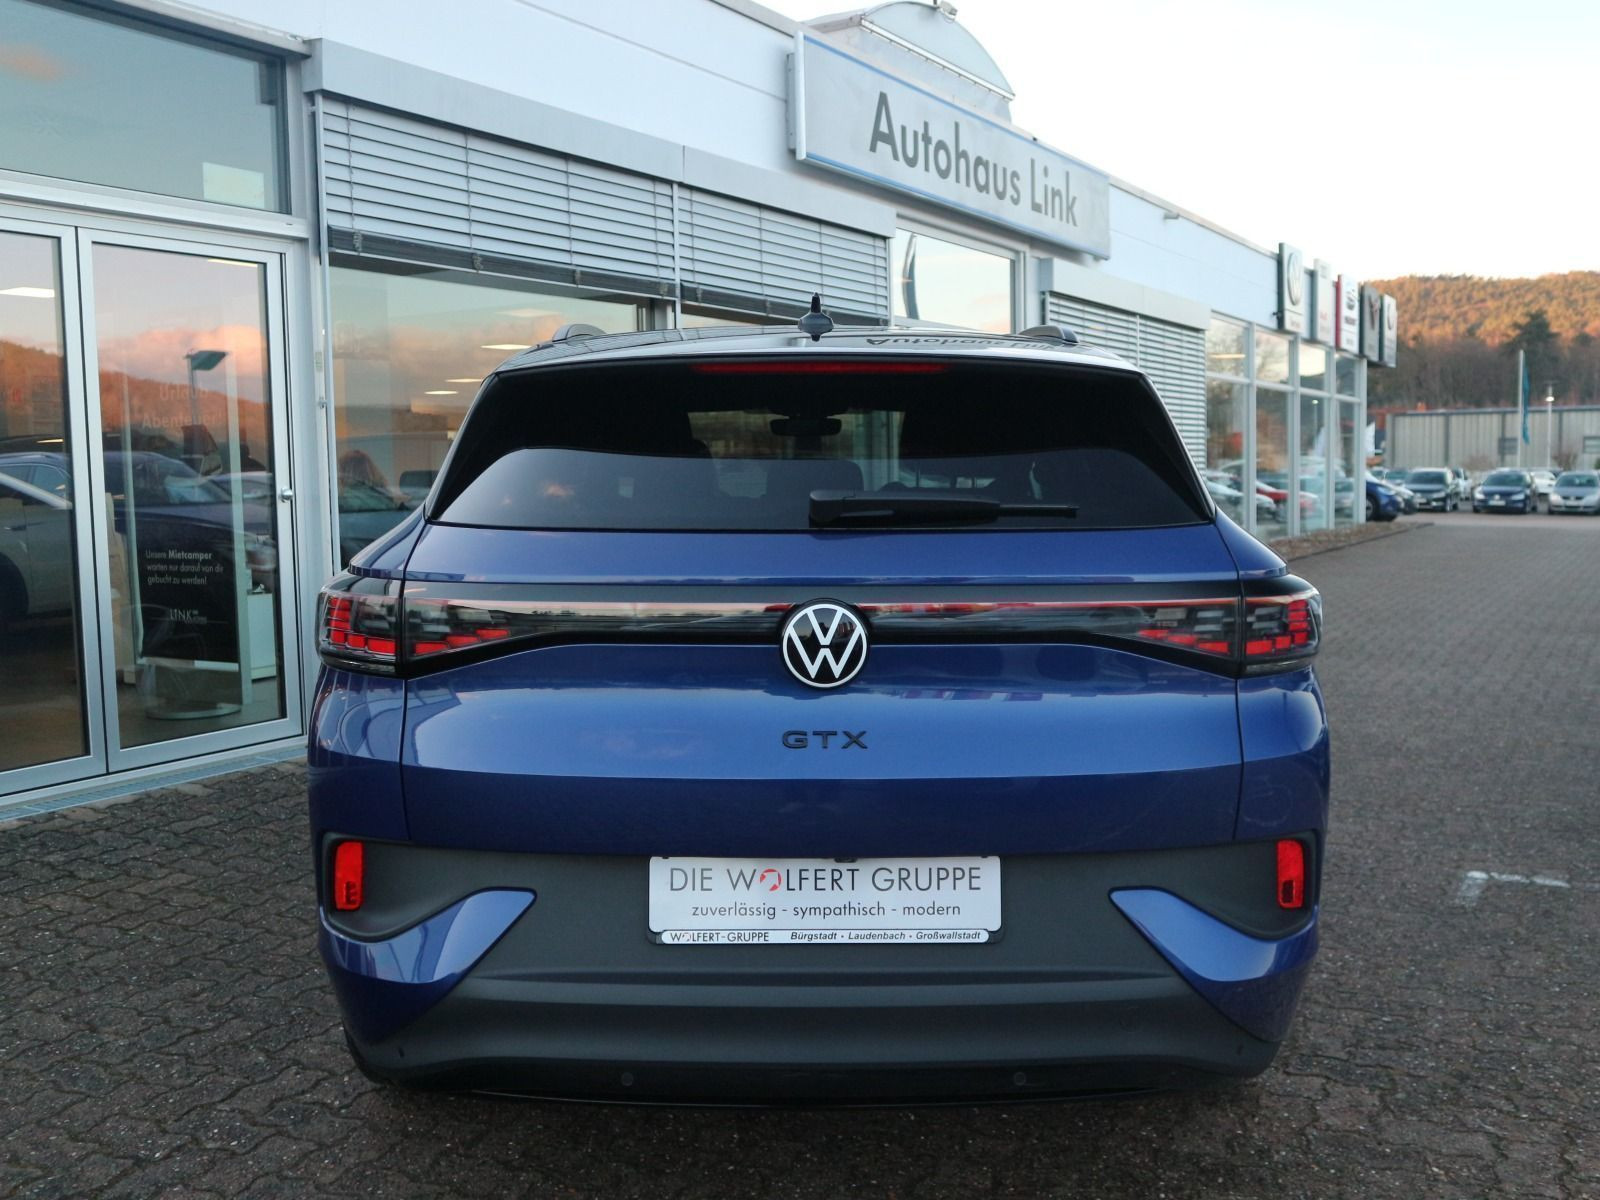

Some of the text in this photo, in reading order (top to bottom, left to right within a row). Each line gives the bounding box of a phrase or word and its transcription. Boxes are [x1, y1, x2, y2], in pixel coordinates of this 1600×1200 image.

[869, 91, 1077, 227] Autohaus Link
[168, 549, 212, 562] Mietcamper
[180, 562, 201, 573] darauf
[147, 574, 172, 586] gebucht
[782, 730, 868, 749] GTX
[669, 866, 982, 892] DIE WOLFERT GRUPPE
[691, 902, 776, 920] zuverlässig
[792, 901, 886, 920] sympathisch
[902, 901, 961, 917] modern
[790, 931, 837, 941] Bürgstadt
[848, 931, 905, 940] Laudenbach
[916, 931, 981, 940] Großwallstadt
